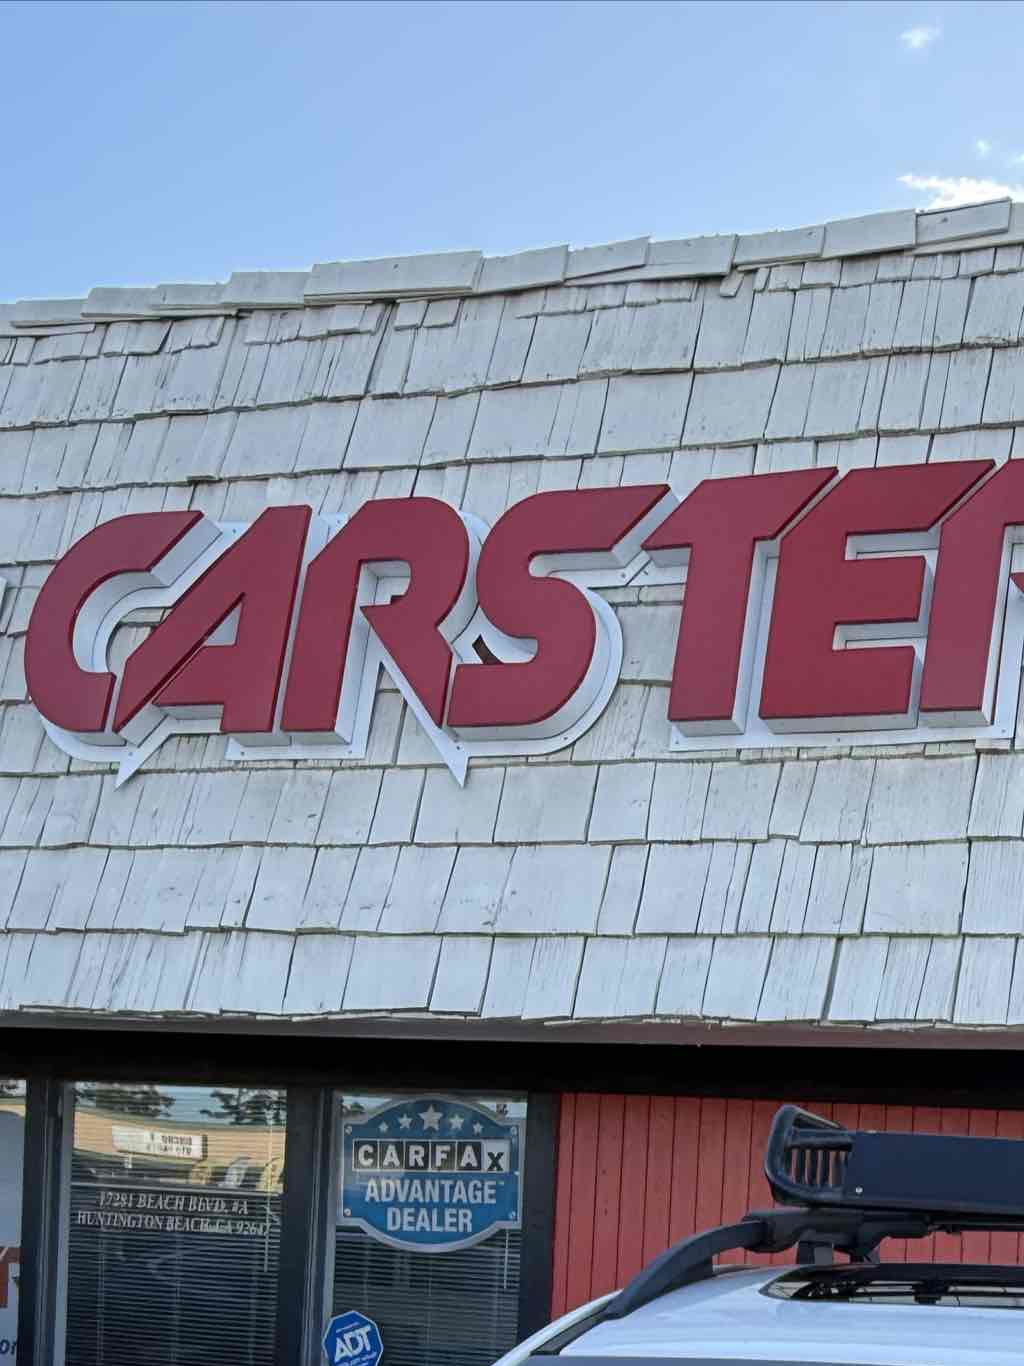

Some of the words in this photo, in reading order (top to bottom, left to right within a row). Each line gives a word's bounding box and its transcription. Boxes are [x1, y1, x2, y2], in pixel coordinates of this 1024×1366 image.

[358, 1144, 504, 1172] CARFAX
[136, 1193, 185, 1211] BEACH
[365, 1177, 497, 1204] ADVANTAGE
[78, 1211, 162, 1230] HUNTINGTON
[386, 1207, 473, 1233] DEALER
[335, 1325, 371, 1363] ADT
